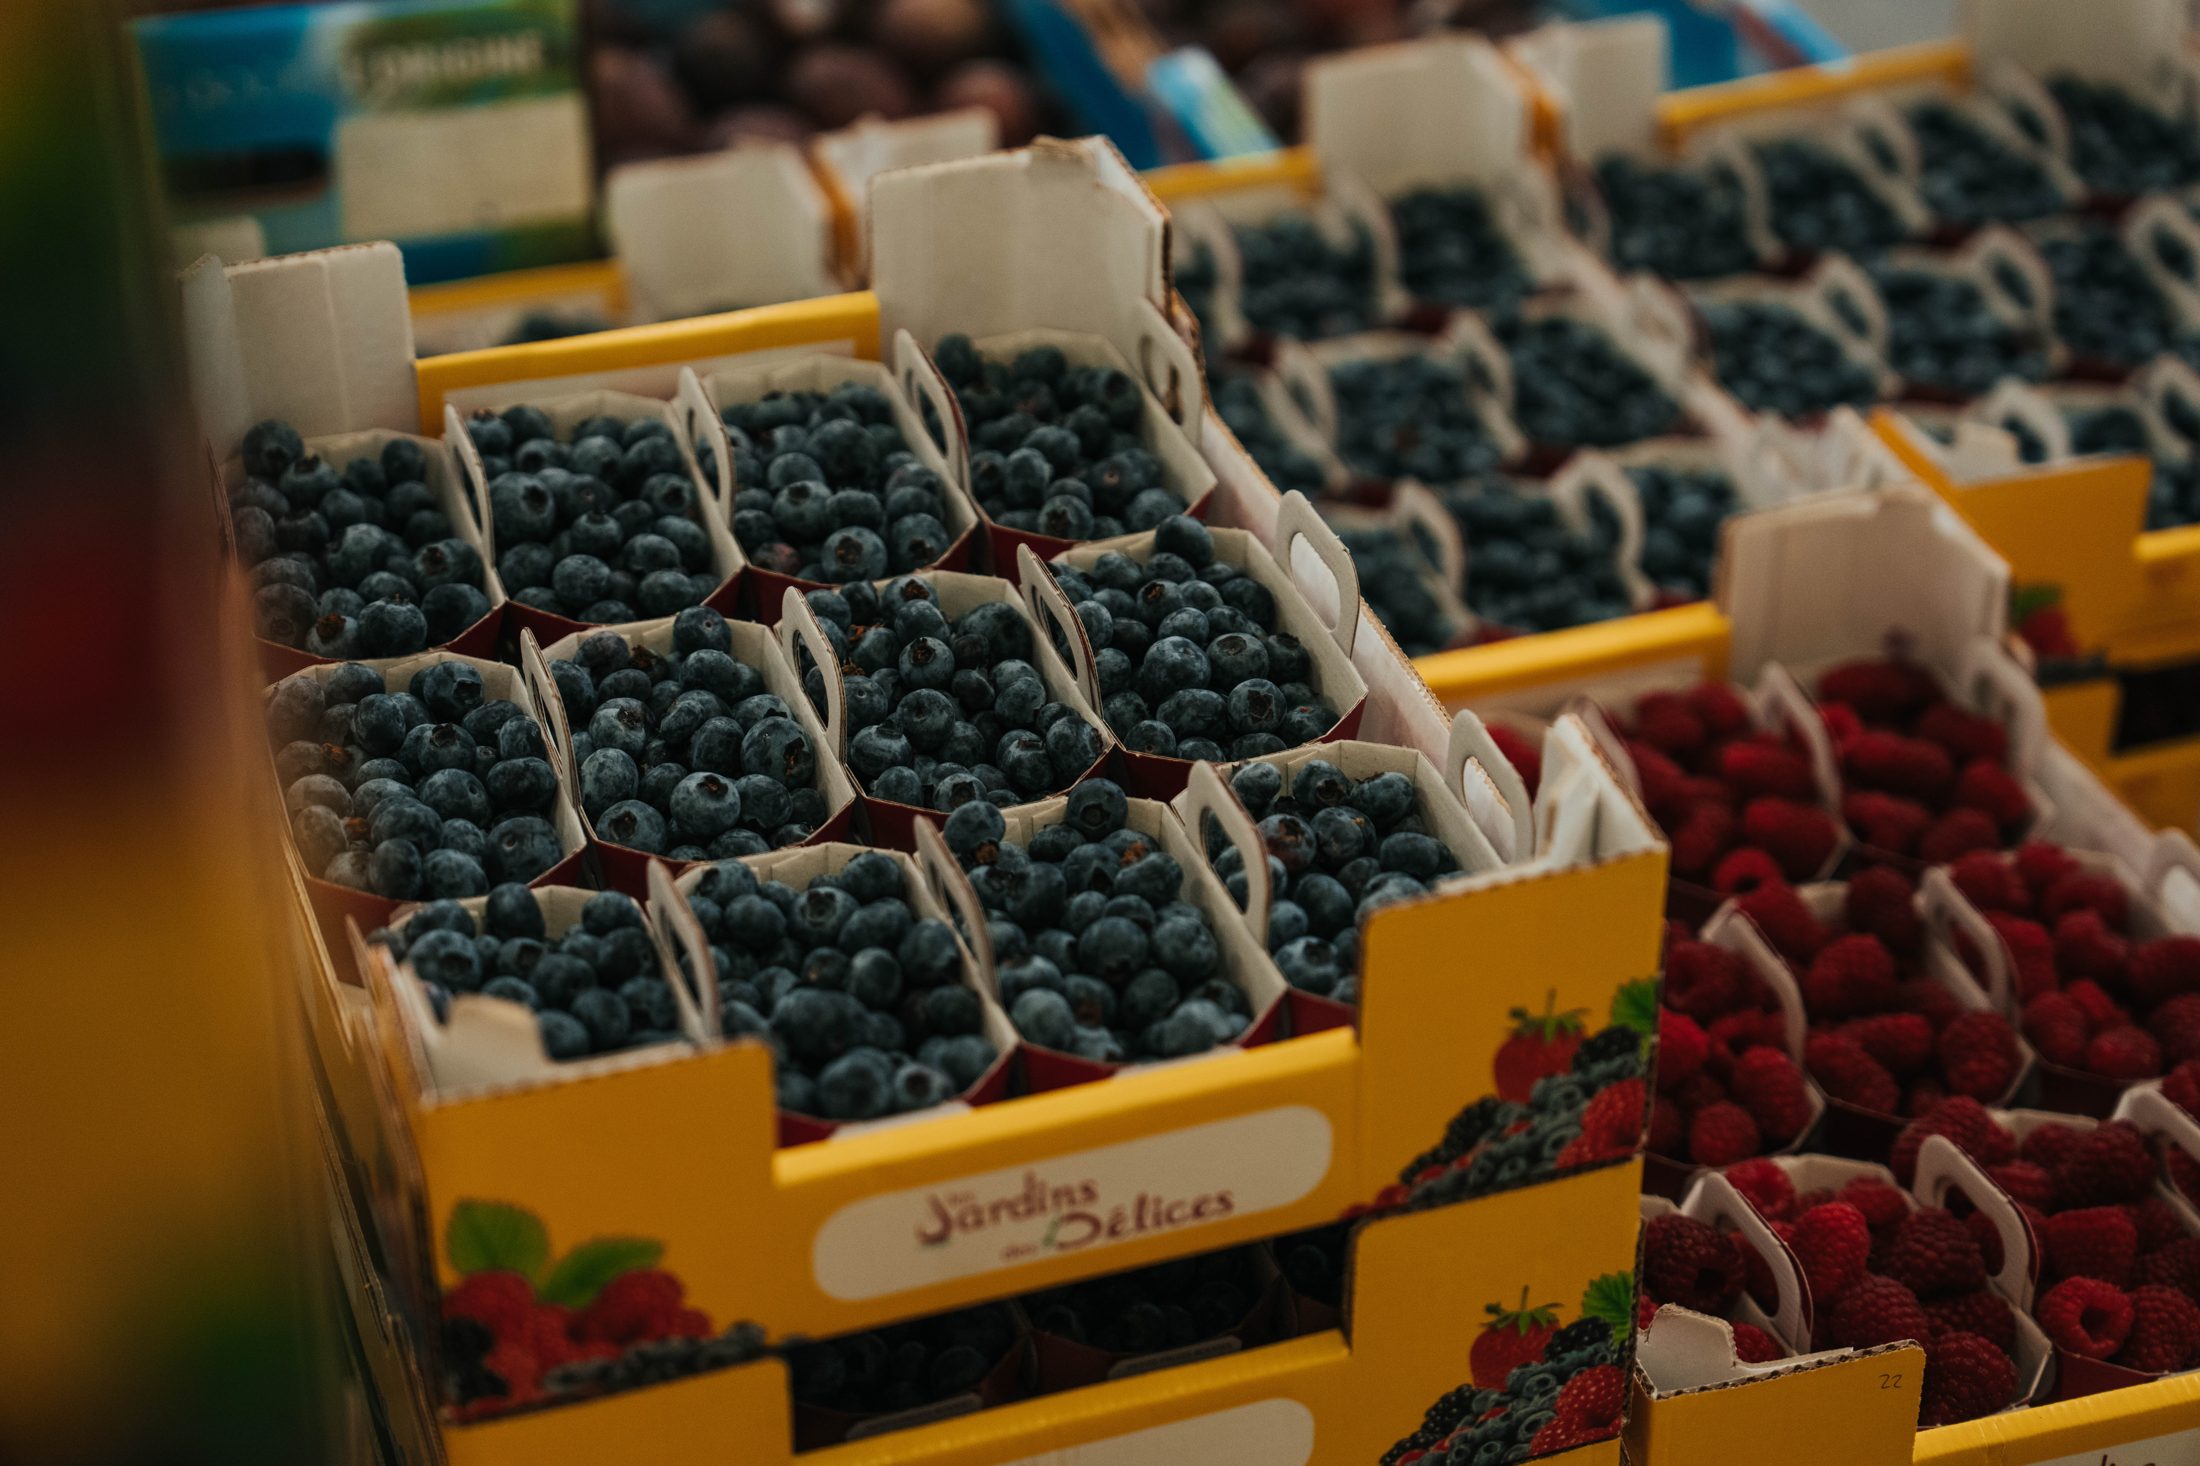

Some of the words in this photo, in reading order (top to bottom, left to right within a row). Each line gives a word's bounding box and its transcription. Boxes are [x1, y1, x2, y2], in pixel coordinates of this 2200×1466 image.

[914, 1168, 1099, 1246] Jardins
[1043, 1190, 1234, 1250] Délices
[1879, 1373, 1903, 1389] 22
